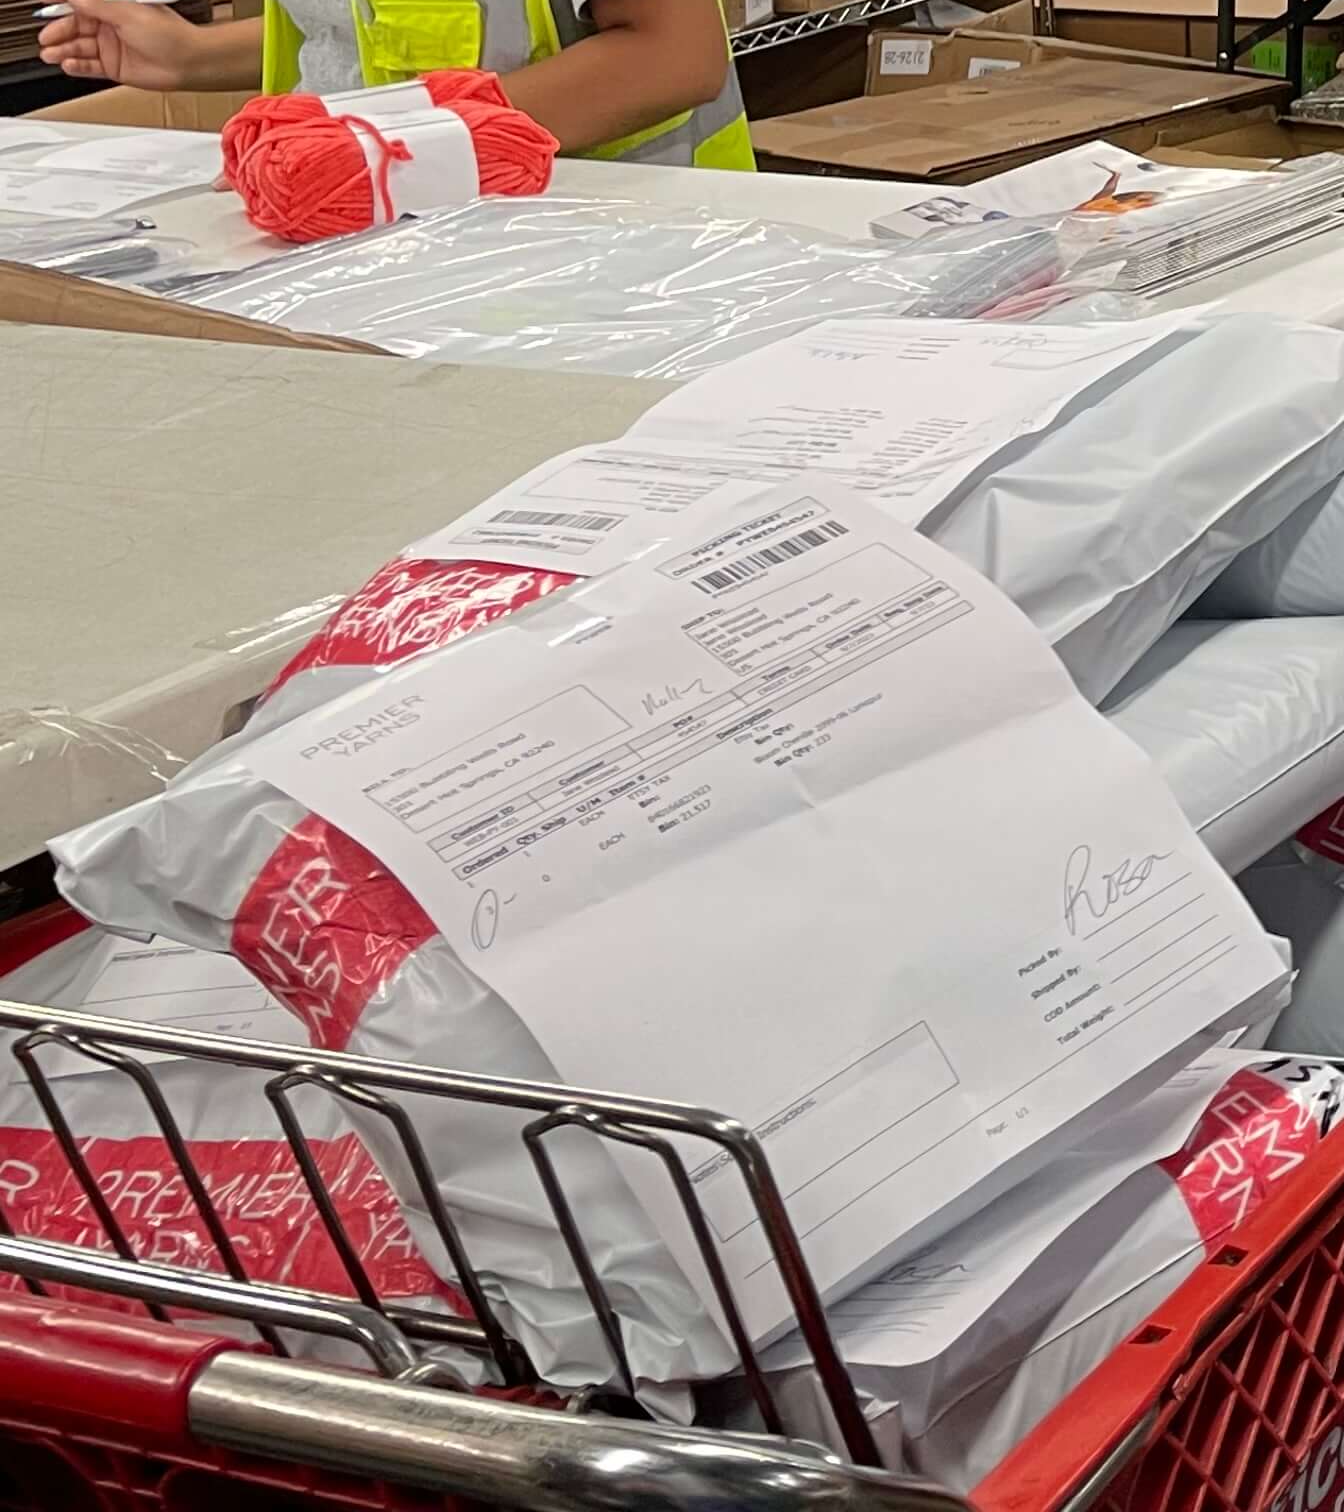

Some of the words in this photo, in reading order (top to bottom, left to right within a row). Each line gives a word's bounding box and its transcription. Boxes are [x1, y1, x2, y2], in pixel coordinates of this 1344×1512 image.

[691, 529, 742, 557] PICKING
[741, 512, 783, 534] TICKET
[300, 694, 425, 761] PREMIER
[332, 712, 422, 759] YARNS
[461, 845, 510, 875] Ordered
[606, 779, 637, 798] Item
[716, 707, 774, 740] Description
[577, 809, 607, 828] EACH
[598, 831, 627, 852] EACH
[1056, 1026, 1081, 1045] Total
